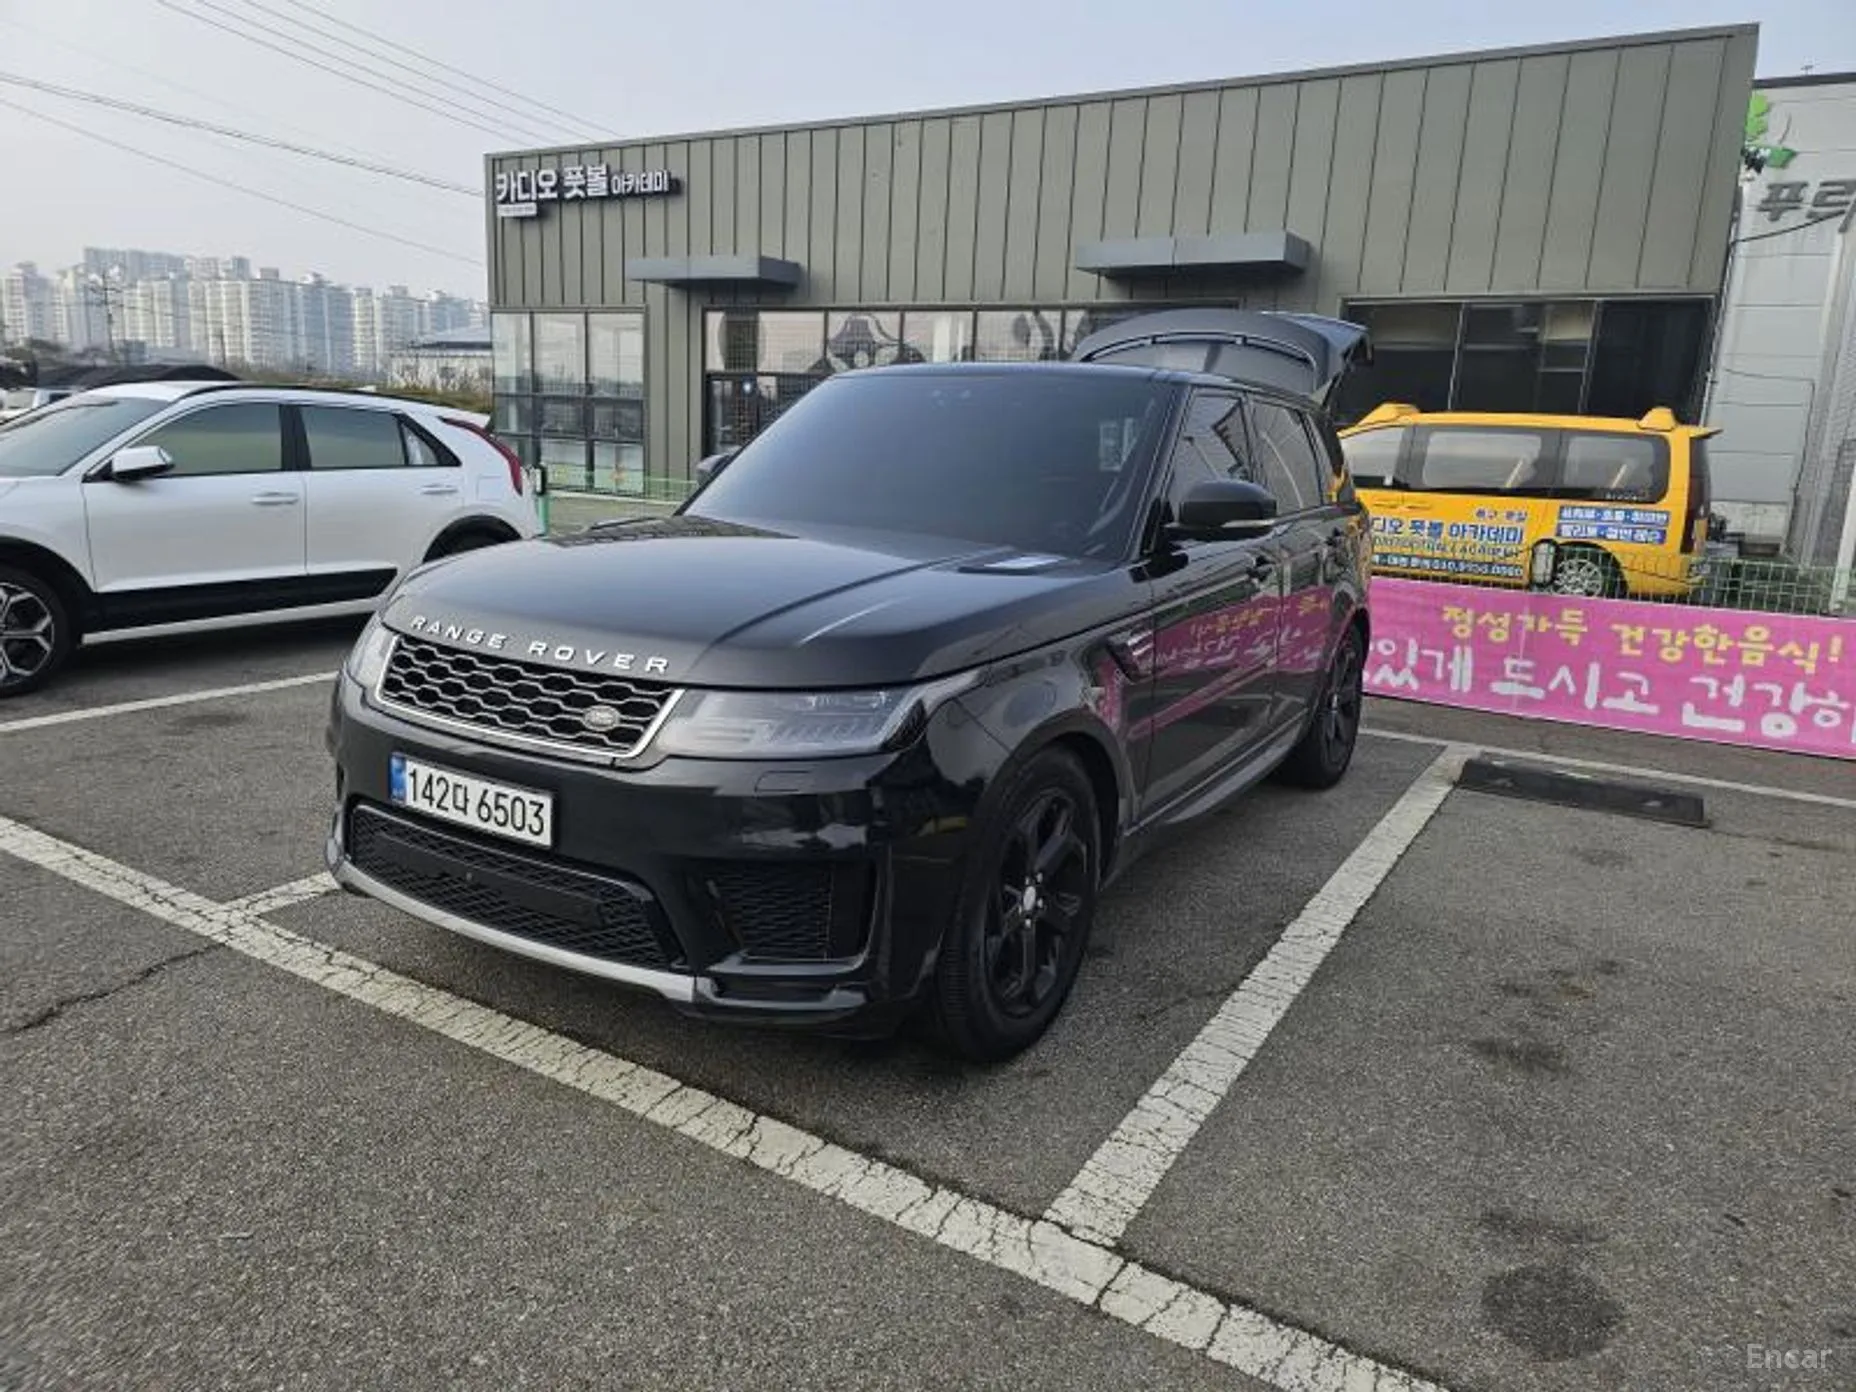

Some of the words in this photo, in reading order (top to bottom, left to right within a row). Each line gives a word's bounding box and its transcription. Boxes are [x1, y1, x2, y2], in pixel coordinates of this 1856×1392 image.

[496, 169, 558, 203] 카디오
[563, 163, 608, 199] 풋볼
[611, 170, 670, 194] 아카데미
[410, 615, 507, 650] RANGE
[528, 641, 670, 674] ROVER
[1442, 605, 1588, 646] 정성가득
[1362, 638, 1473, 693] 있게
[1489, 656, 1660, 715] 드시고
[408, 767, 470, 816] 142다
[477, 788, 545, 837] 6503
